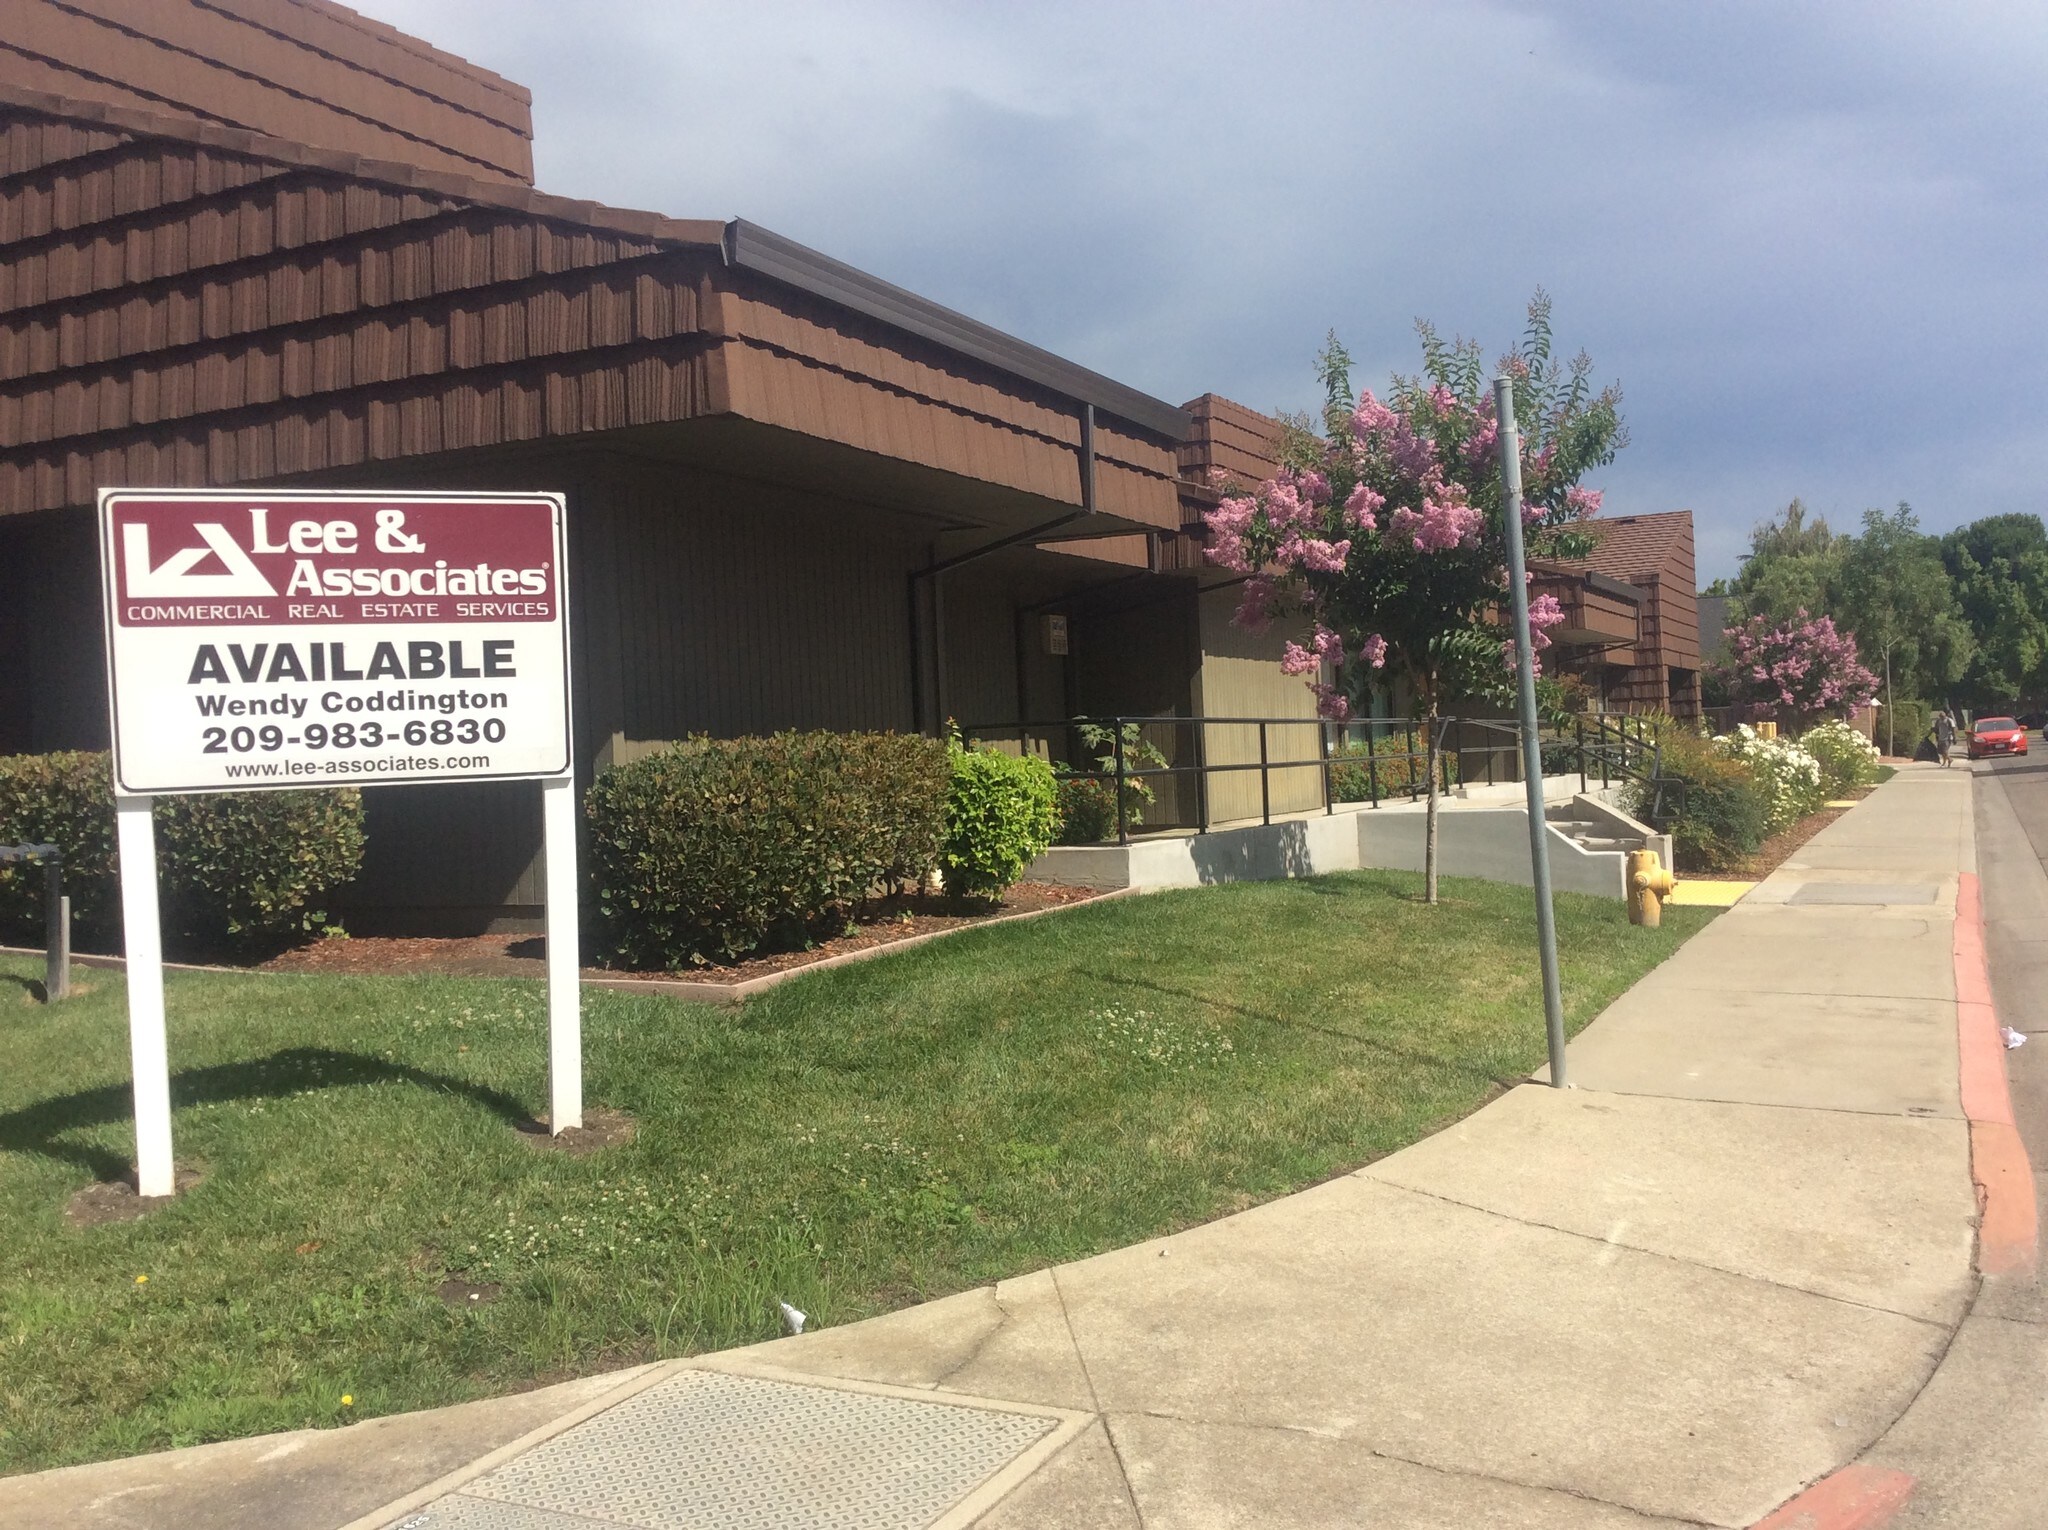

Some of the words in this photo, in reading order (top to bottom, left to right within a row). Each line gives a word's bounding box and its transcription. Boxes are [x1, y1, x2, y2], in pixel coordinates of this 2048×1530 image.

[249, 508, 359, 554] Lee
[374, 509, 426, 554] &
[127, 604, 270, 621] COMMERCIAL
[288, 603, 344, 619] REAL
[361, 602, 440, 618] ESTATE
[456, 602, 549, 617] SERVICES
[187, 639, 517, 684] AVAILABLE
[195, 693, 309, 719] Wendy
[320, 689, 508, 715] Coddington
[202, 718, 506, 754] 209-983-6830
[225, 755, 490, 778] www.lee-associates.com
